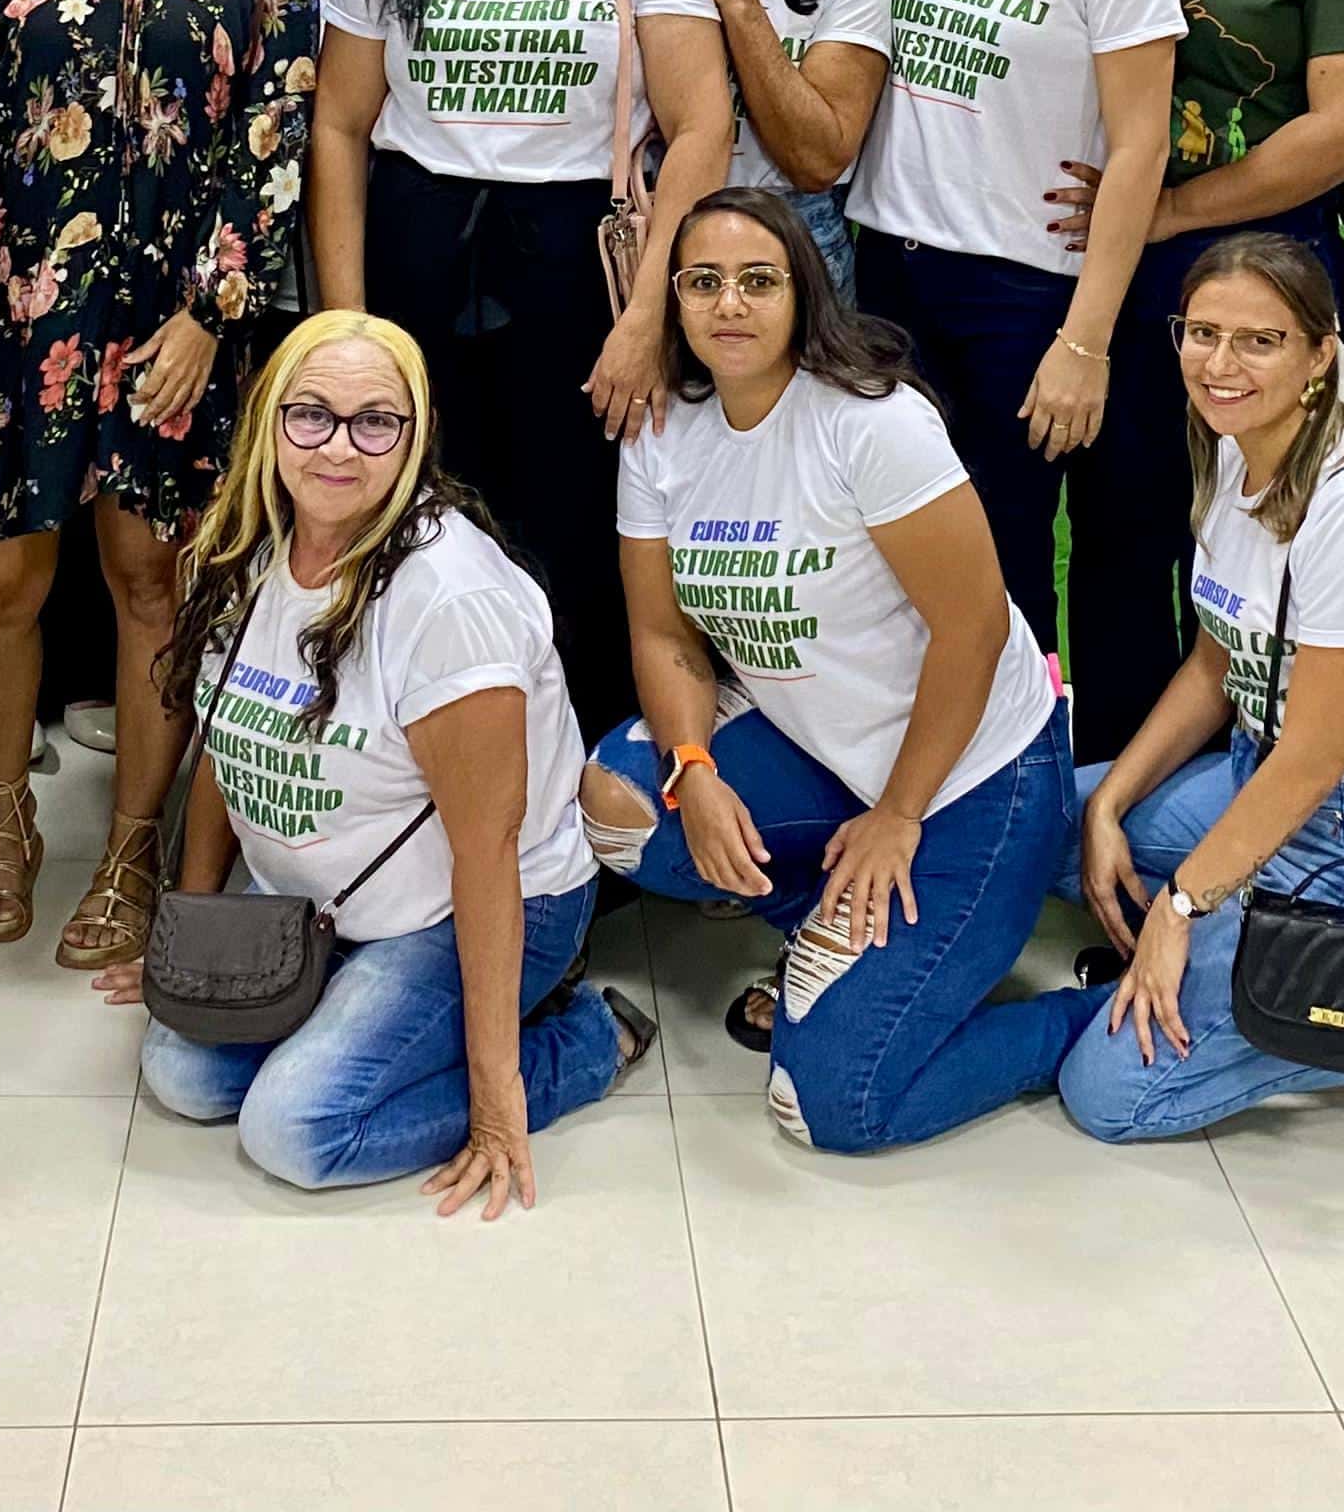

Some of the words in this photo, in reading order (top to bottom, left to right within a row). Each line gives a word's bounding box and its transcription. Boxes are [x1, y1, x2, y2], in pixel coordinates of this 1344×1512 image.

[413, 27, 588, 55] INDUSTRIAL
[407, 58, 437, 84] DO
[444, 56, 600, 87] VESTUÁRIO
[906, 58, 979, 101] MALHA
[427, 86, 466, 113] EM
[471, 87, 568, 114] MALHA
[751, 519, 782, 542] DE
[670, 546, 779, 578] STUREIRO
[675, 583, 801, 614] NDUSTRIAL
[1193, 574, 1229, 609] CURSO
[1226, 592, 1248, 619] DE
[698, 615, 818, 645] VESTUÁRIO
[734, 638, 803, 671] MALHA
[206, 726, 327, 782] DUSTRIAL
[219, 759, 344, 813] VESTUÁRIO
[244, 794, 319, 839] MALHA
